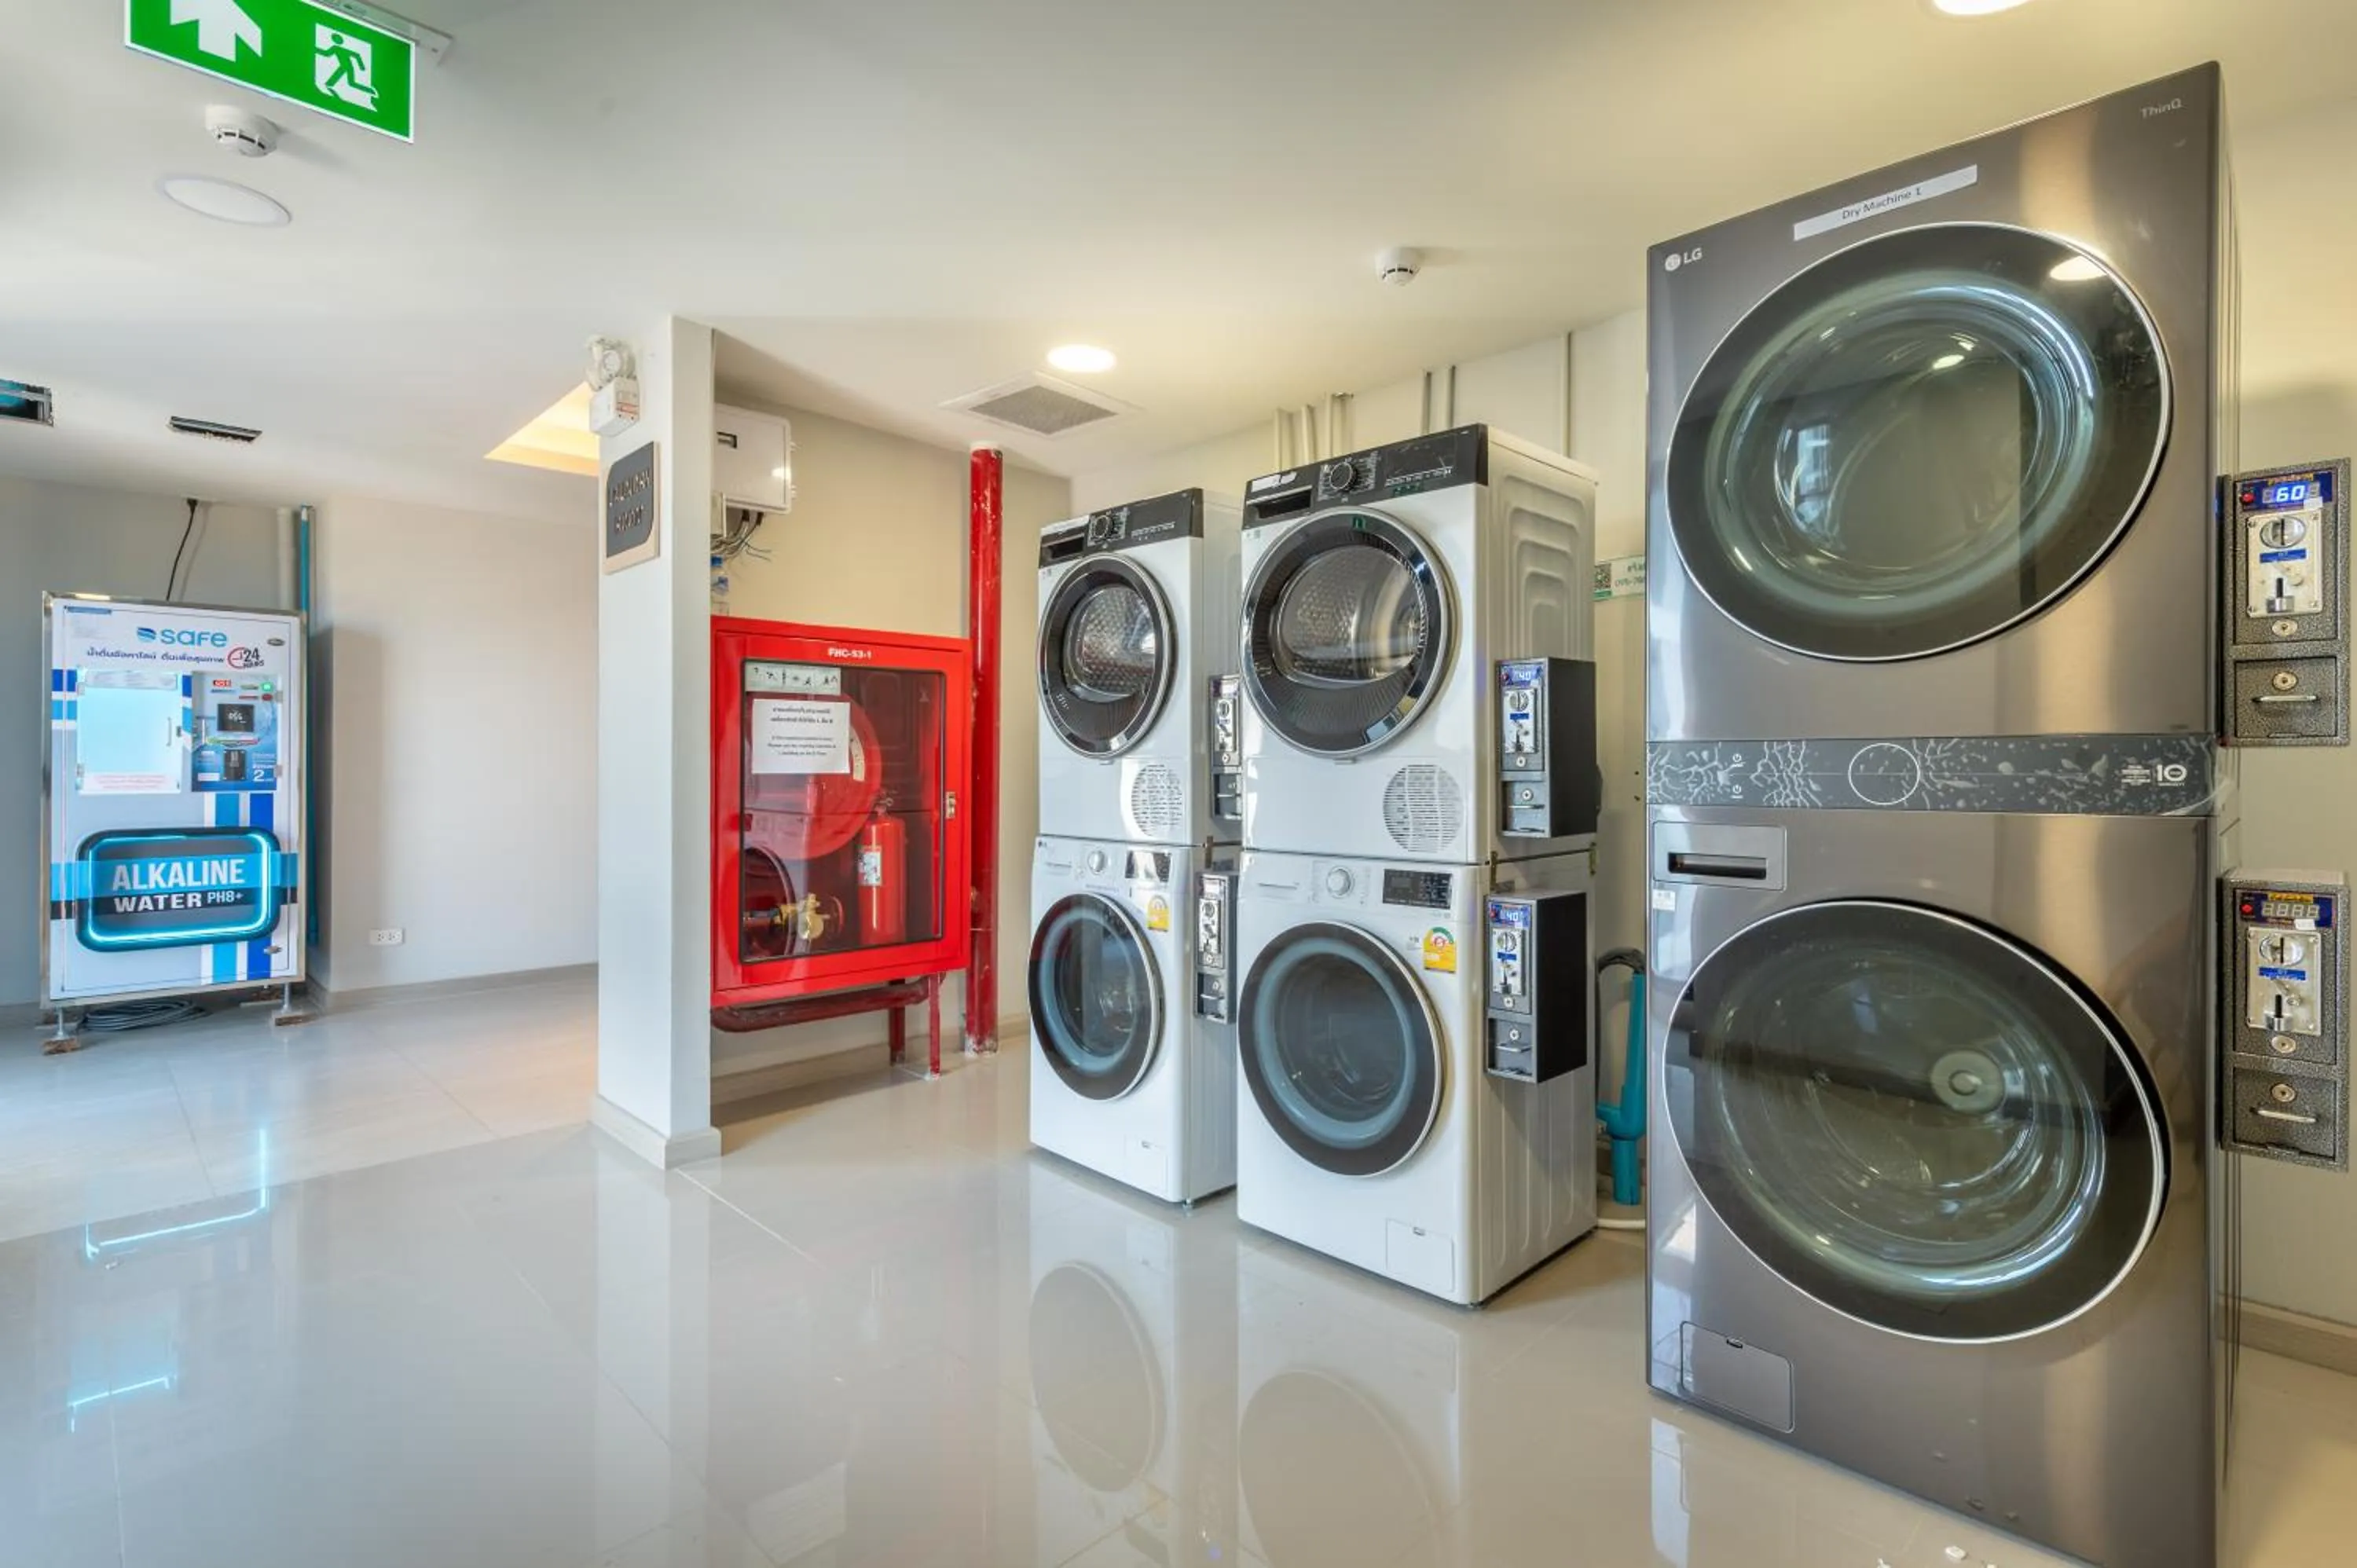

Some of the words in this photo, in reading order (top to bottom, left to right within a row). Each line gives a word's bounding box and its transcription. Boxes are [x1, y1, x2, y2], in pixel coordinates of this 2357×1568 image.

[2140, 97, 2183, 119] ThinQ
[1842, 208, 1862, 220] Dry
[1863, 191, 1912, 213] Machine
[1684, 247, 1703, 264] LG
[2275, 485, 2306, 503] 60
[243, 647, 260, 662] 24
[253, 769, 265, 782] 2
[112, 859, 245, 891] ALKALINE
[114, 892, 202, 913] WATER
[207, 890, 244, 904] PH8+
